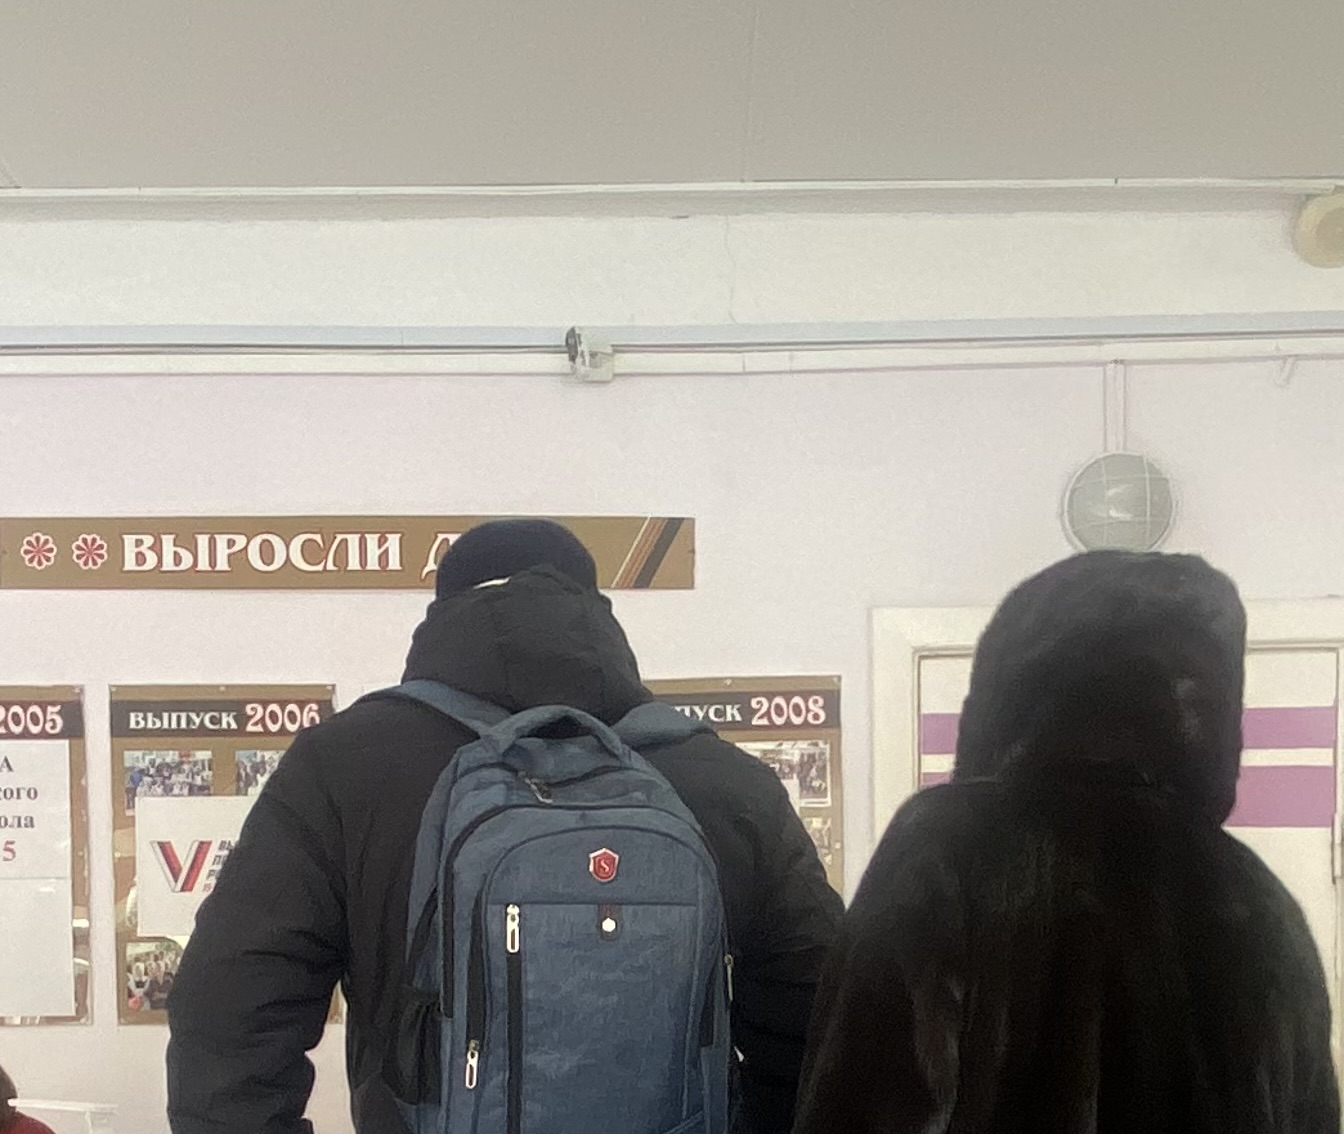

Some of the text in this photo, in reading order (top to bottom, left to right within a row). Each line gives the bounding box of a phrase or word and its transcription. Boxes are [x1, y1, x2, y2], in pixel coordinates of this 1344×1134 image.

[121, 532, 403, 573] ВЫРОСЛИ
[128, 703, 321, 733] ВЫПУСК 2006
[751, 695, 826, 726] 2008
[3, 840, 17, 862] 5
